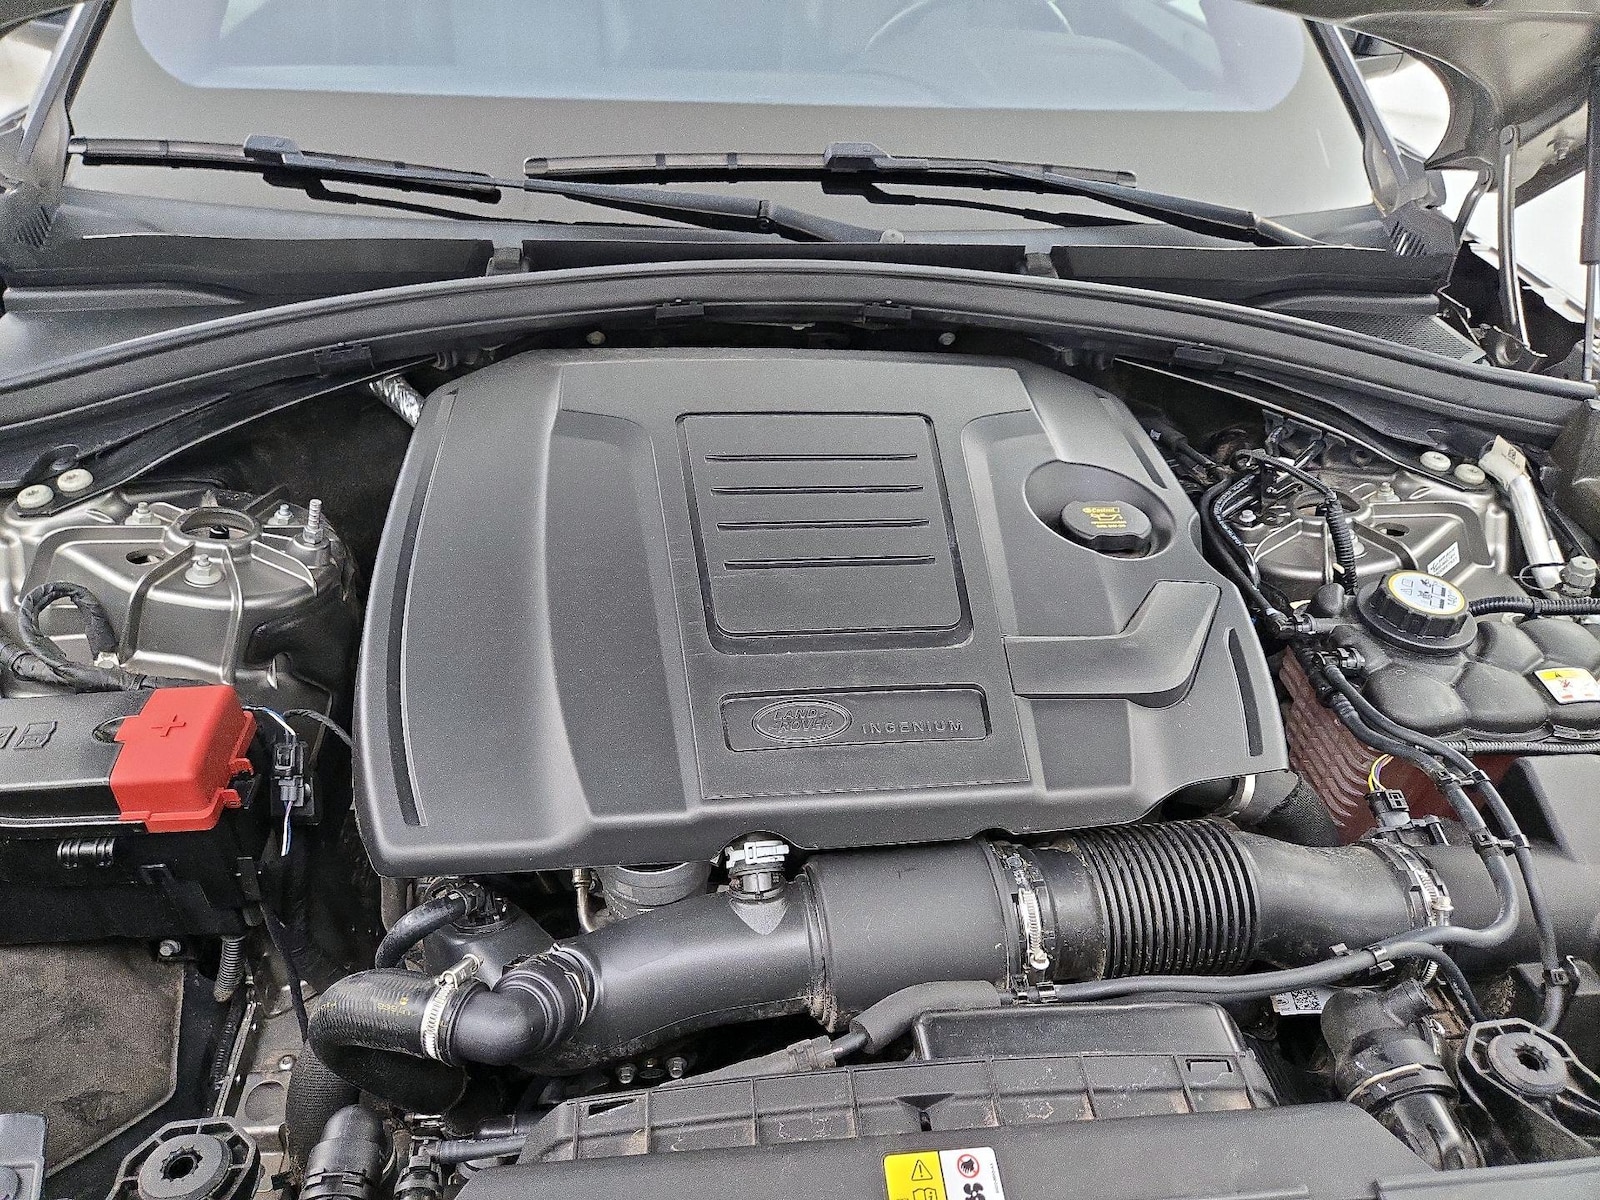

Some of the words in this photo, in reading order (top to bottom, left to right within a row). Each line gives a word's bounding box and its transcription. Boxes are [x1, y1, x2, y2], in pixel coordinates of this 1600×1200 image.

[773, 708, 818, 721] LAND
[779, 719, 834, 732] ROVER
[861, 719, 963, 734] INGENIUM
